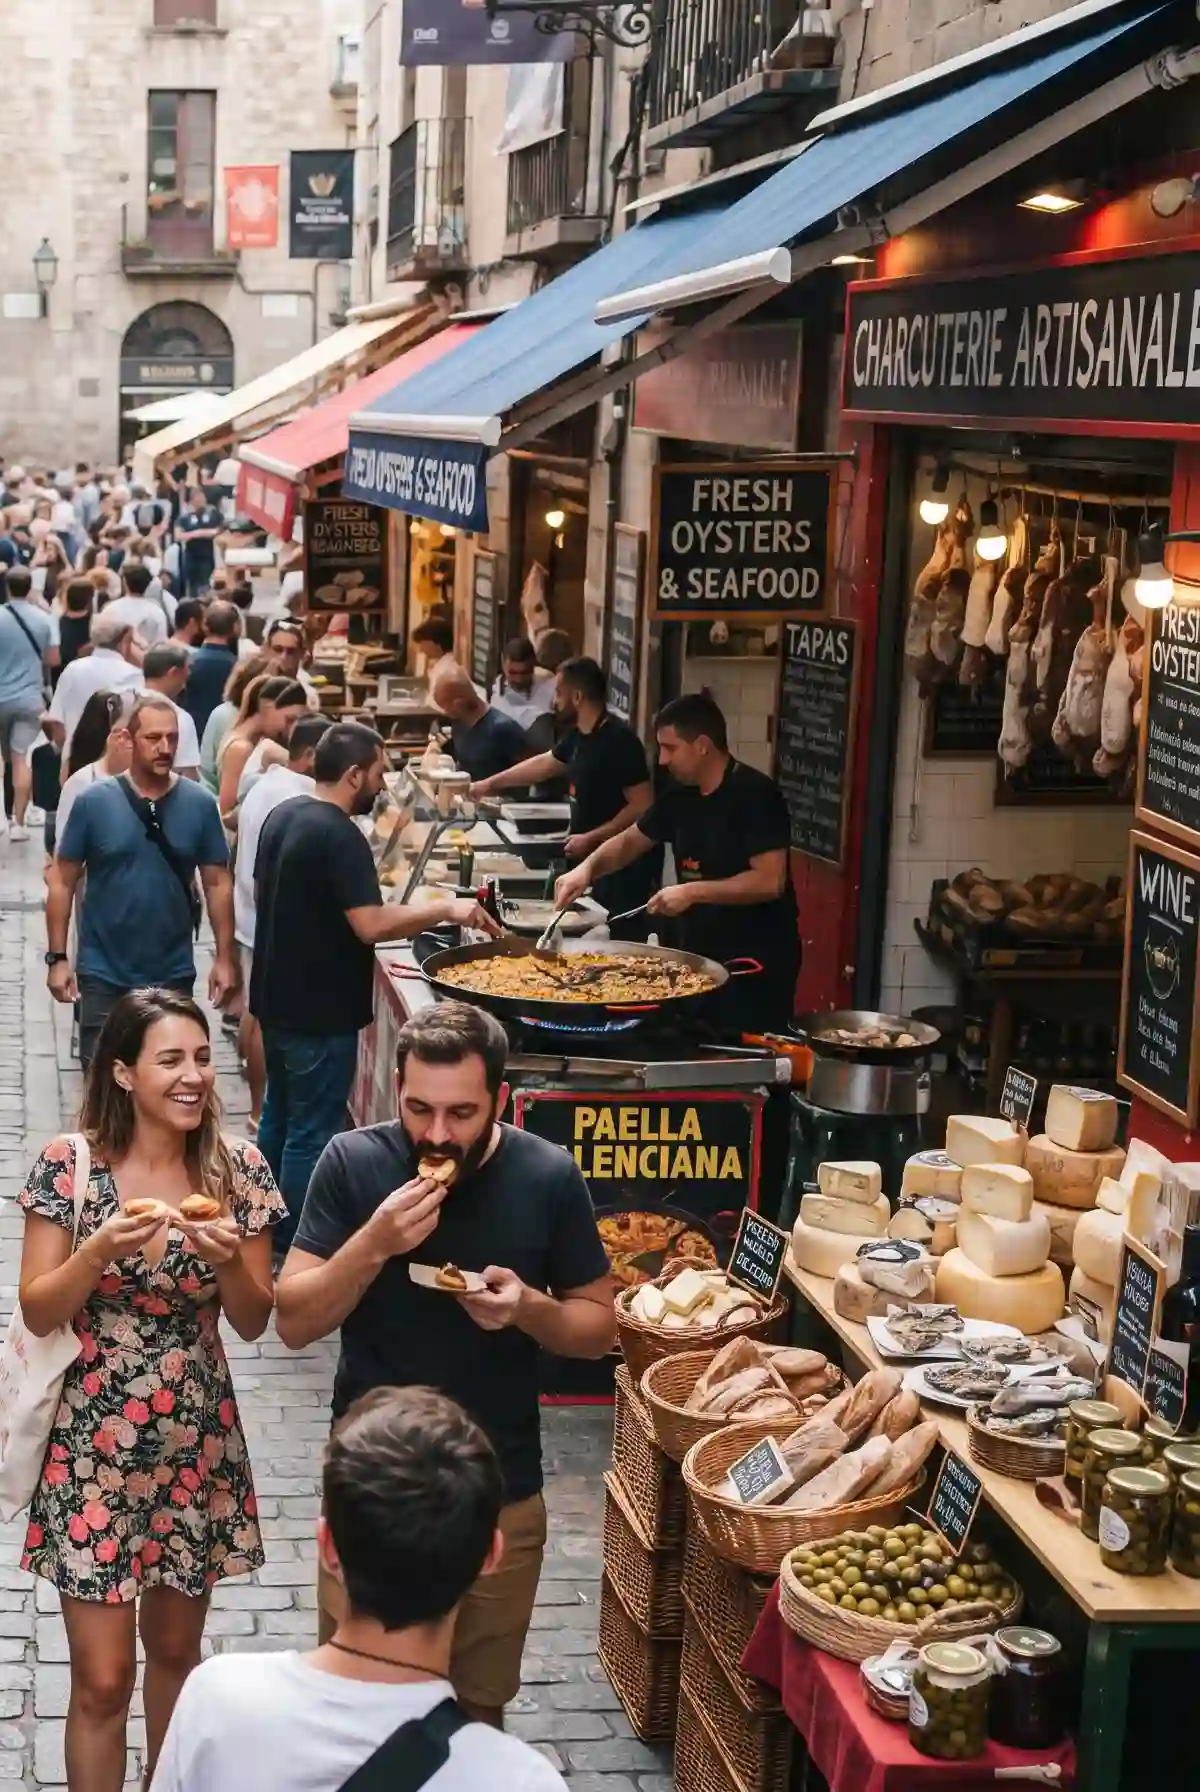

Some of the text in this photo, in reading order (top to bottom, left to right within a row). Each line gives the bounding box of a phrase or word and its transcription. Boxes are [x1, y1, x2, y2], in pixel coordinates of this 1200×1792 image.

[853, 306, 1007, 388] CHARCUTERIE
[1009, 288, 1200, 390] ARTISANALE
[692, 478, 793, 512] FRESH
[671, 520, 812, 554] OYSTERS
[659, 567, 820, 599] & SEAFOOD
[786, 623, 848, 665] TAPAS
[1139, 854, 1195, 924] WINE
[574, 1106, 703, 1141] PAELLA
[574, 1145, 743, 1179] LENCIANA
